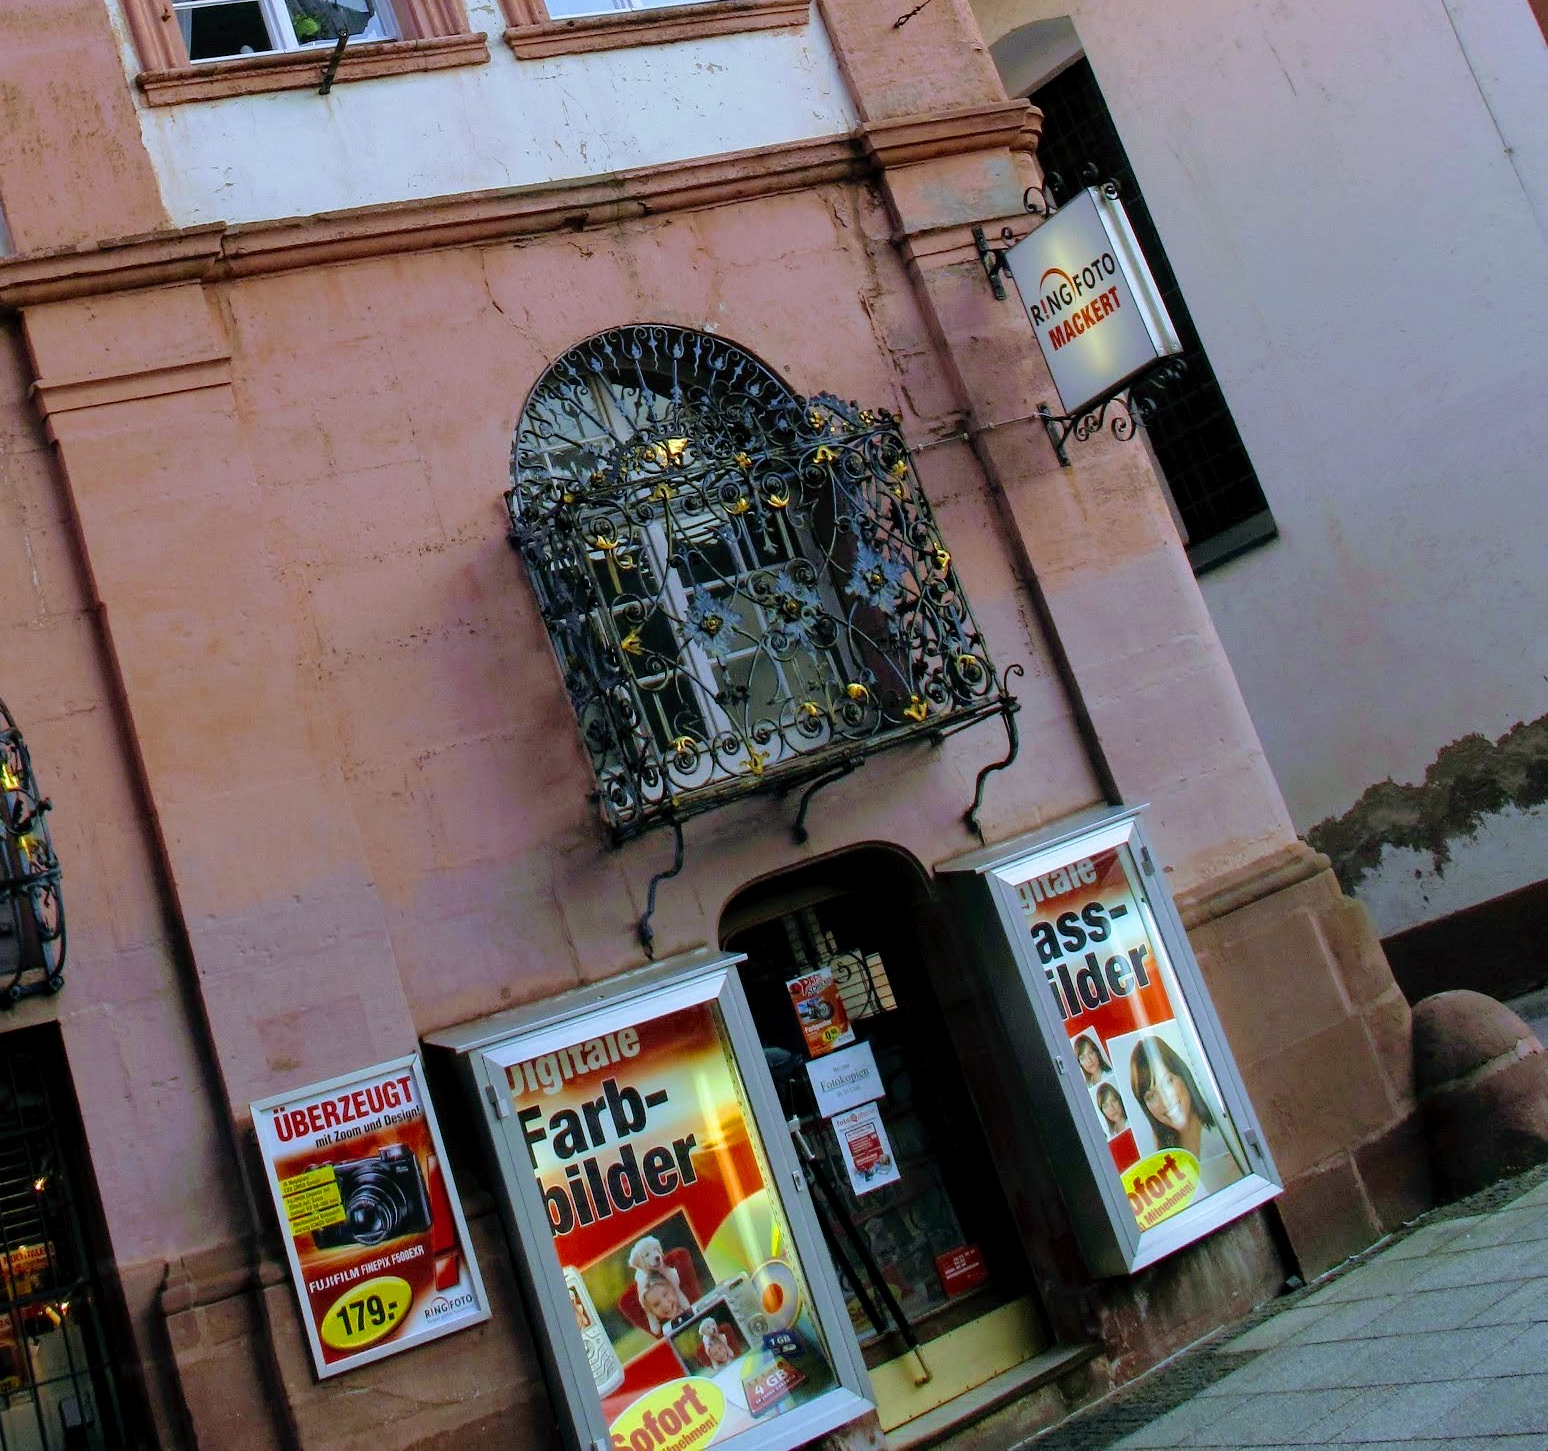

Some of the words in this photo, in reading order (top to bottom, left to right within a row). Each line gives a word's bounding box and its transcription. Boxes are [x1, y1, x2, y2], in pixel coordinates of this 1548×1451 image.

[1048, 286, 1121, 351] MACKERT
[820, 1068, 870, 1092] Fotokopien
[273, 1076, 413, 1142] ÜBERZEUGT
[315, 1134, 332, 1148] mit
[334, 1125, 362, 1142] Zoom
[364, 1118, 382, 1133] und
[384, 1105, 421, 1123] Design!
[517, 1077, 669, 1170] Farb-
[536, 1133, 698, 1237] bilder
[1144, 1179, 1195, 1226] Mitnehmen!
[309, 1267, 361, 1293] FUJIFILM
[360, 1257, 391, 1276] FINEPIX
[391, 1244, 425, 1266] F500EXR
[777, 1334, 791, 1345] GB
[754, 1384, 764, 1395] 4
[766, 1369, 789, 1387] GB
